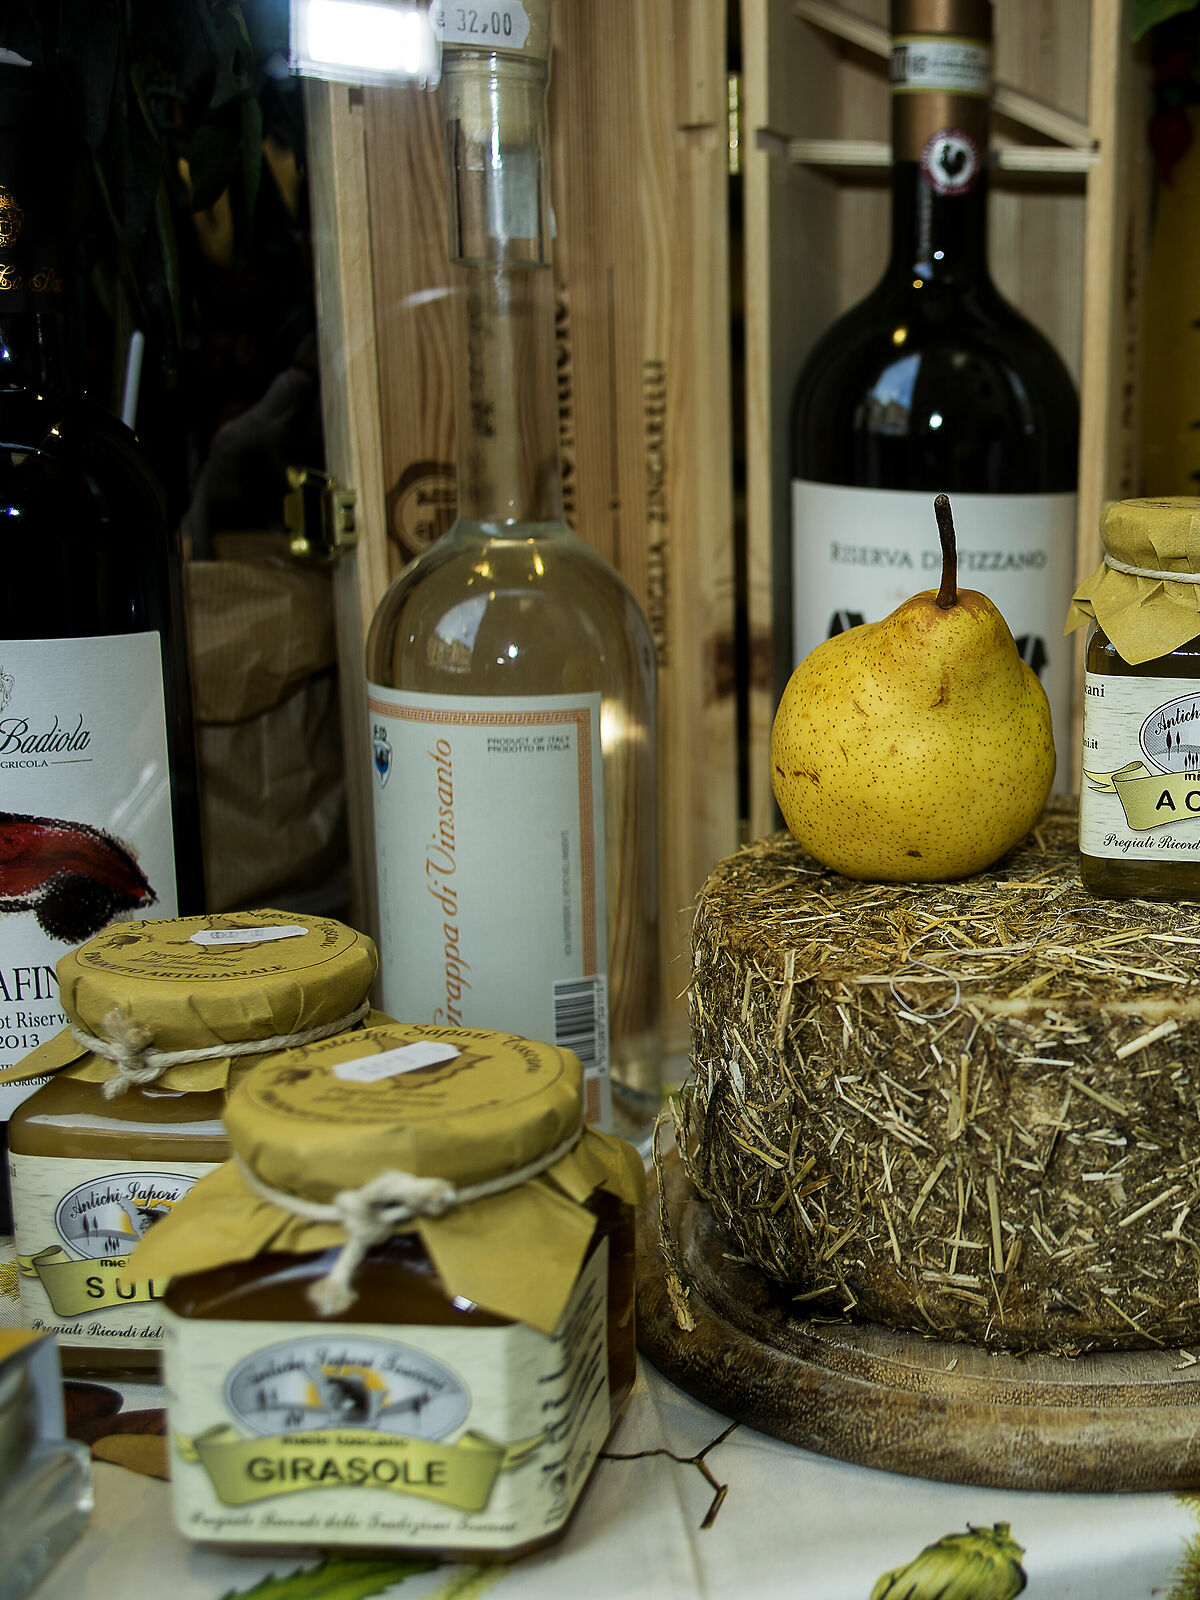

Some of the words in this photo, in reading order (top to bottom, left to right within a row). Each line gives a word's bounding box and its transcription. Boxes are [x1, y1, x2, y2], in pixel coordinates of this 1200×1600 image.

[457, 9, 512, 36] 32,00
[829, 541, 915, 569] RISERVA
[957, 548, 1048, 571] FIZZANO
[0, 713, 91, 755] Badiola
[0, 760, 48, 769] GRICOLA
[425, 738, 458, 878] Vinsanto
[1102, 832, 1157, 854] Pregiati
[426, 879, 459, 918] di
[144, 965, 288, 979] ARTIGIANALE
[430, 929, 472, 1028] Grappa
[0, 1033, 40, 1050] 2013
[403, 1024, 497, 1041] Sapori
[71, 1186, 125, 1219] Antichi
[125, 1181, 182, 1207] Sapori
[100, 1258, 129, 1268] mie
[86, 1276, 165, 1300] SUL
[86, 1321, 140, 1339] Ricordi
[246, 1456, 448, 1487] GIRASOLE
